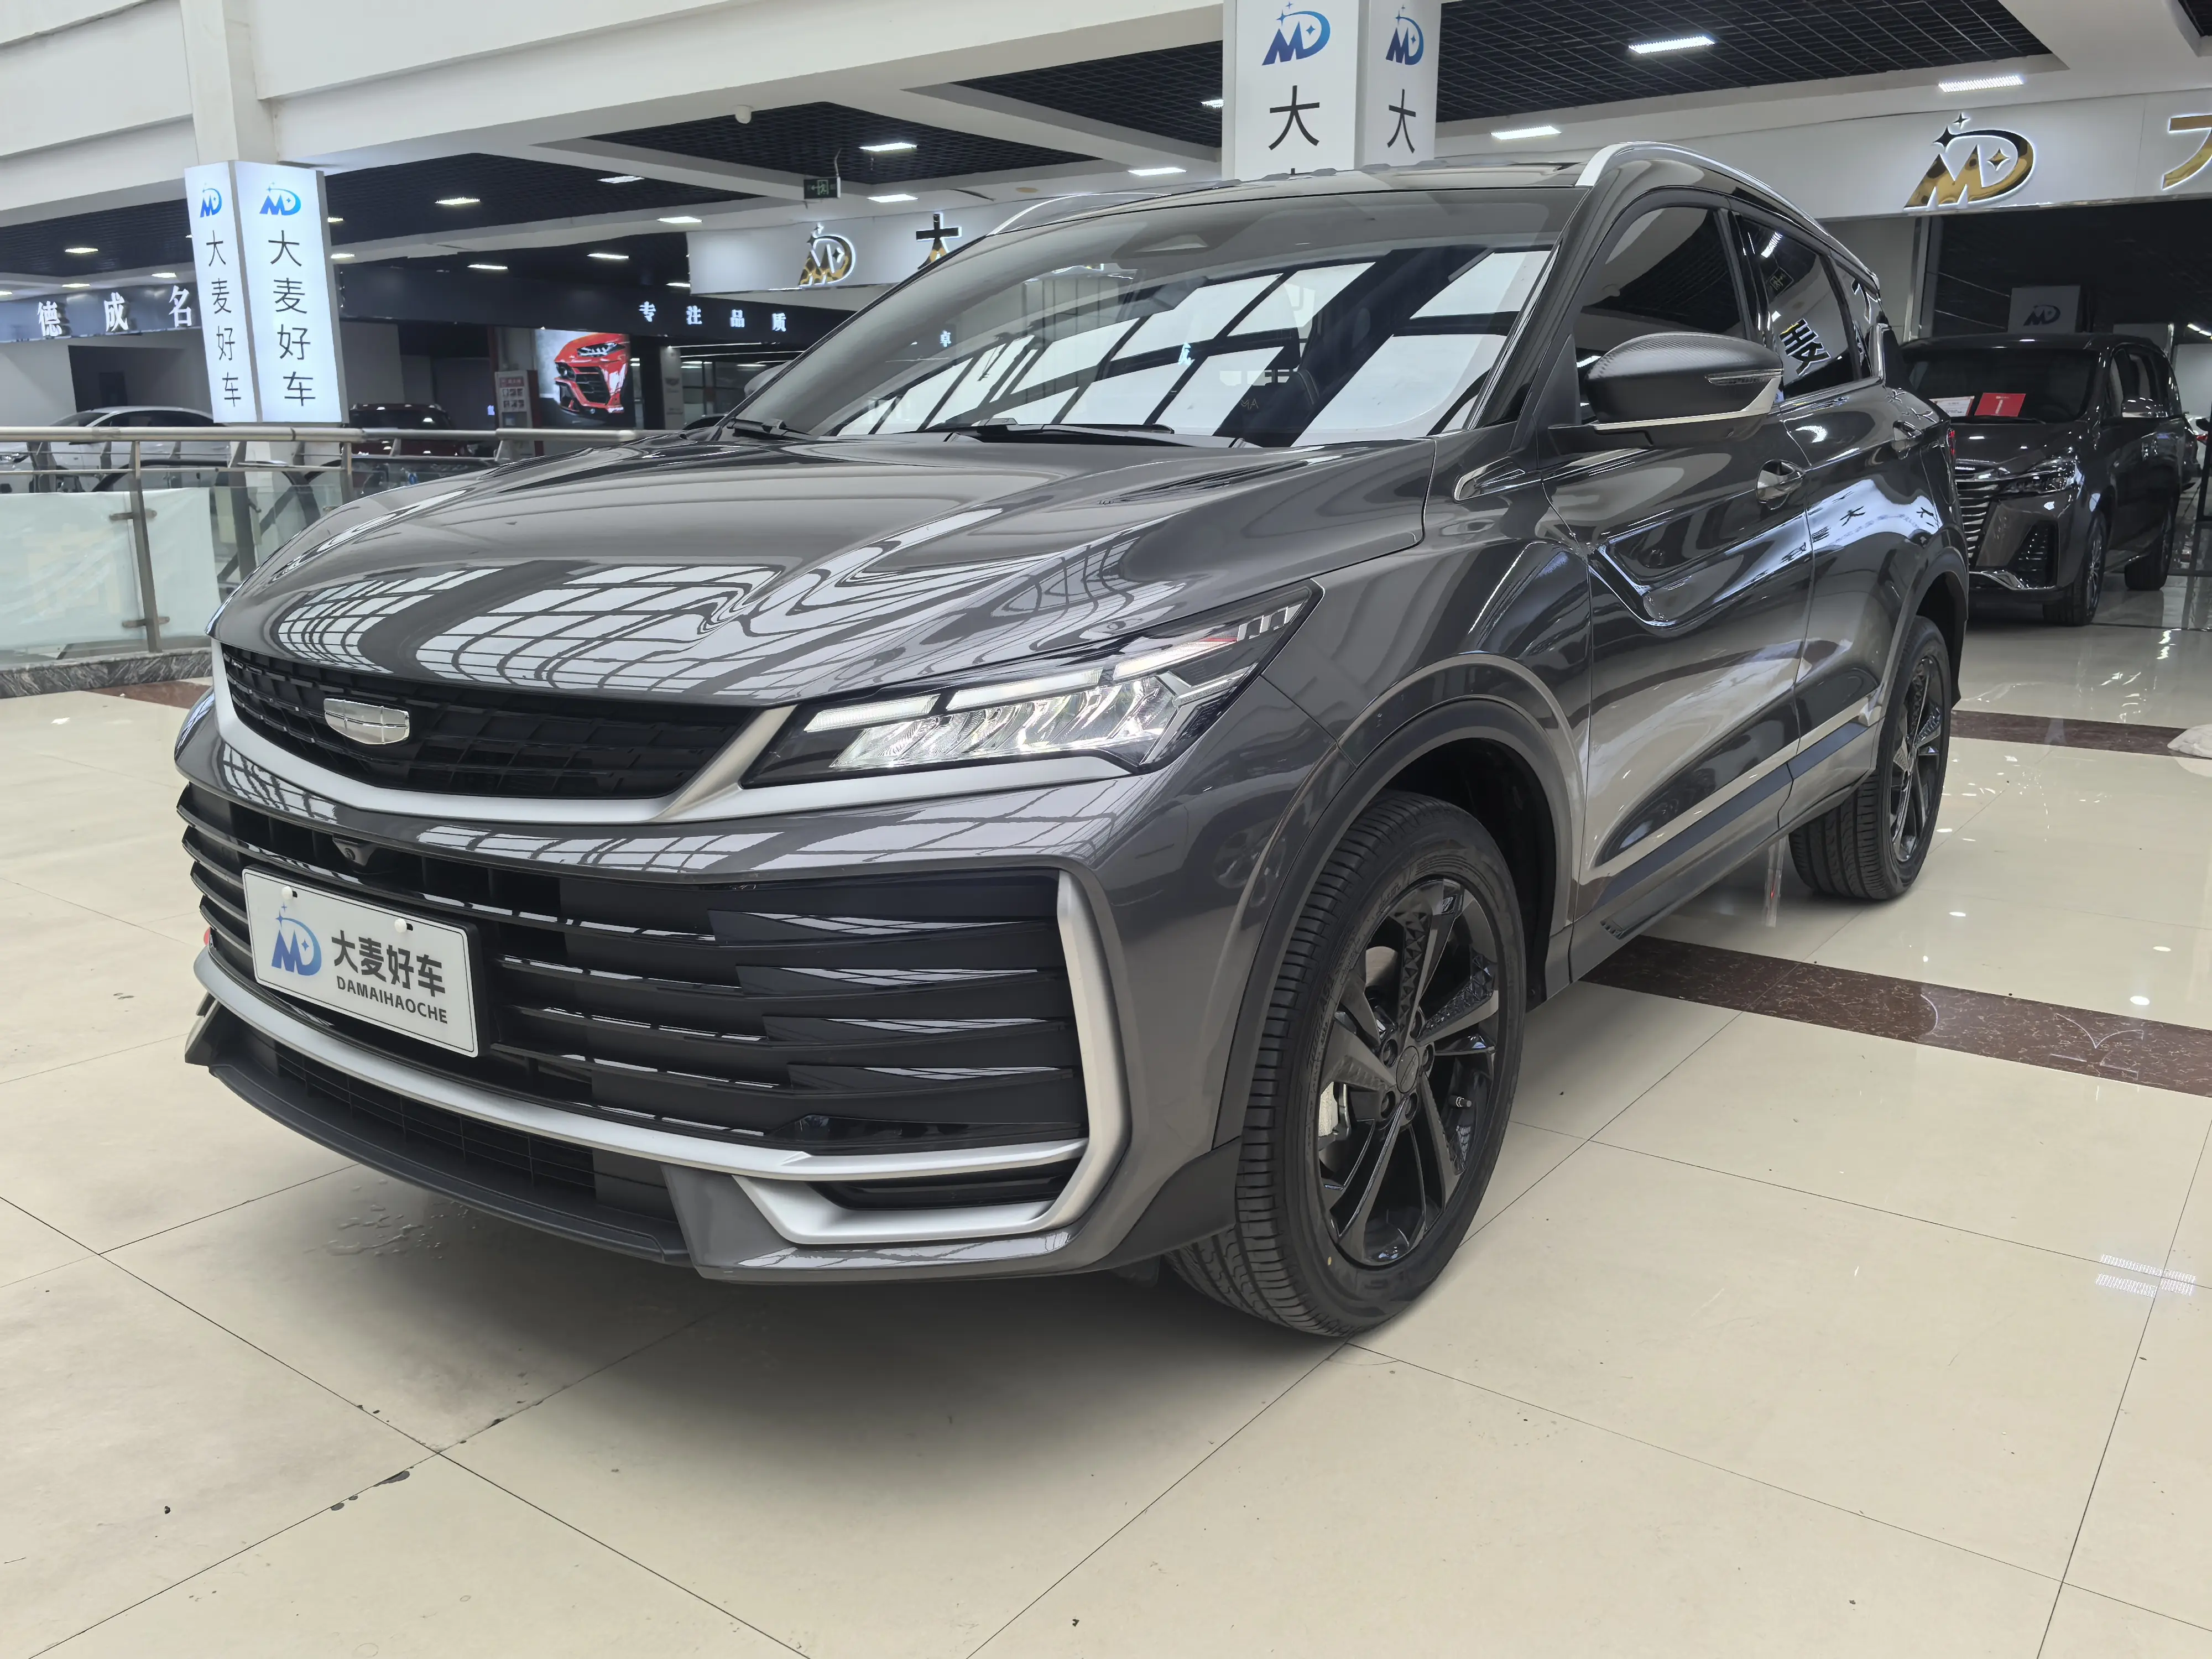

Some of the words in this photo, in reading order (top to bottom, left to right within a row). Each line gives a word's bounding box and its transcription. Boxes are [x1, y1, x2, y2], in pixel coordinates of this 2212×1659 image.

[1269, 85, 1320, 175] 大
[1387, 88, 1416, 154] 大
[916, 213, 962, 269] 大
[36, 285, 193, 337] 德成名
[206, 230, 242, 407] 大麦好车
[268, 229, 316, 406] 大麦好车
[639, 301, 786, 332] 专注品质
[331, 930, 446, 998] 大麦好车
[337, 975, 448, 1024] DAMAIHAOCHE
